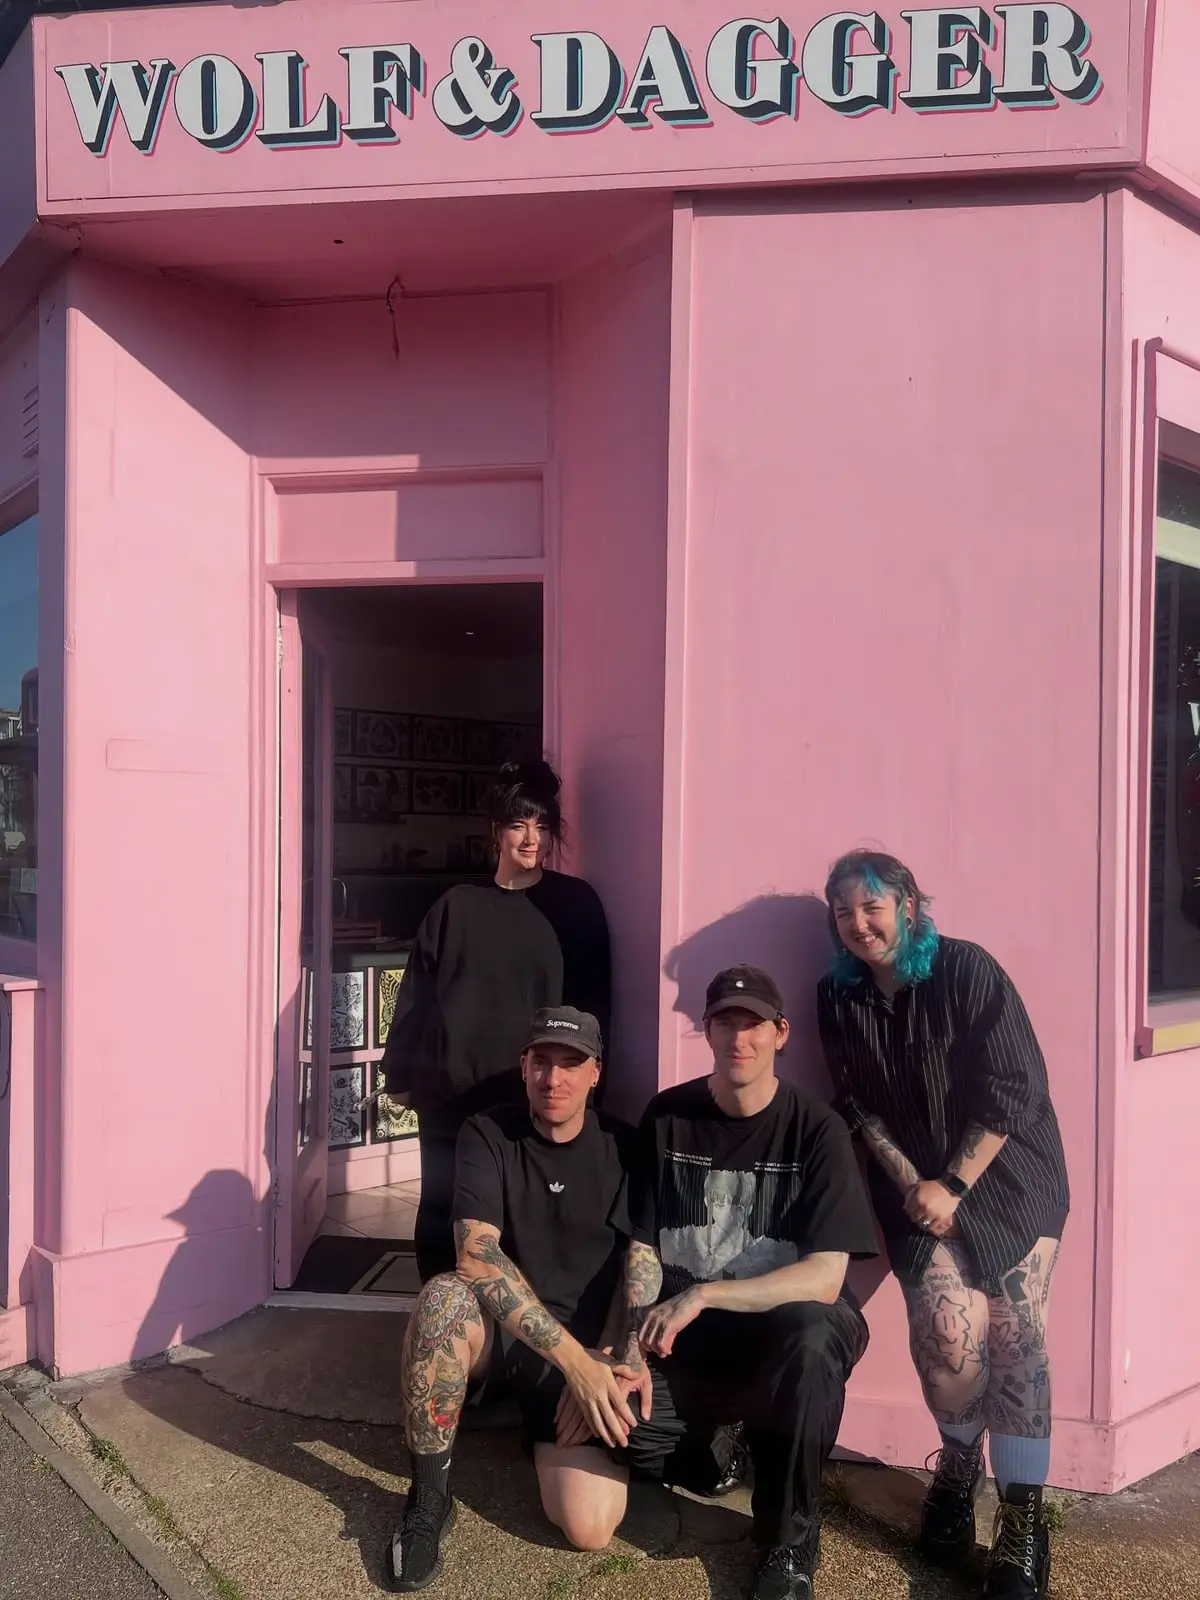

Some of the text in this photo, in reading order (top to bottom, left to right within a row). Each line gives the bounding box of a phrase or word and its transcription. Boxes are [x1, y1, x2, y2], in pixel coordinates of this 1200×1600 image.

[54, 1, 1103, 157] WOLF & DAGGER
[546, 1019, 579, 1030] Supreme
